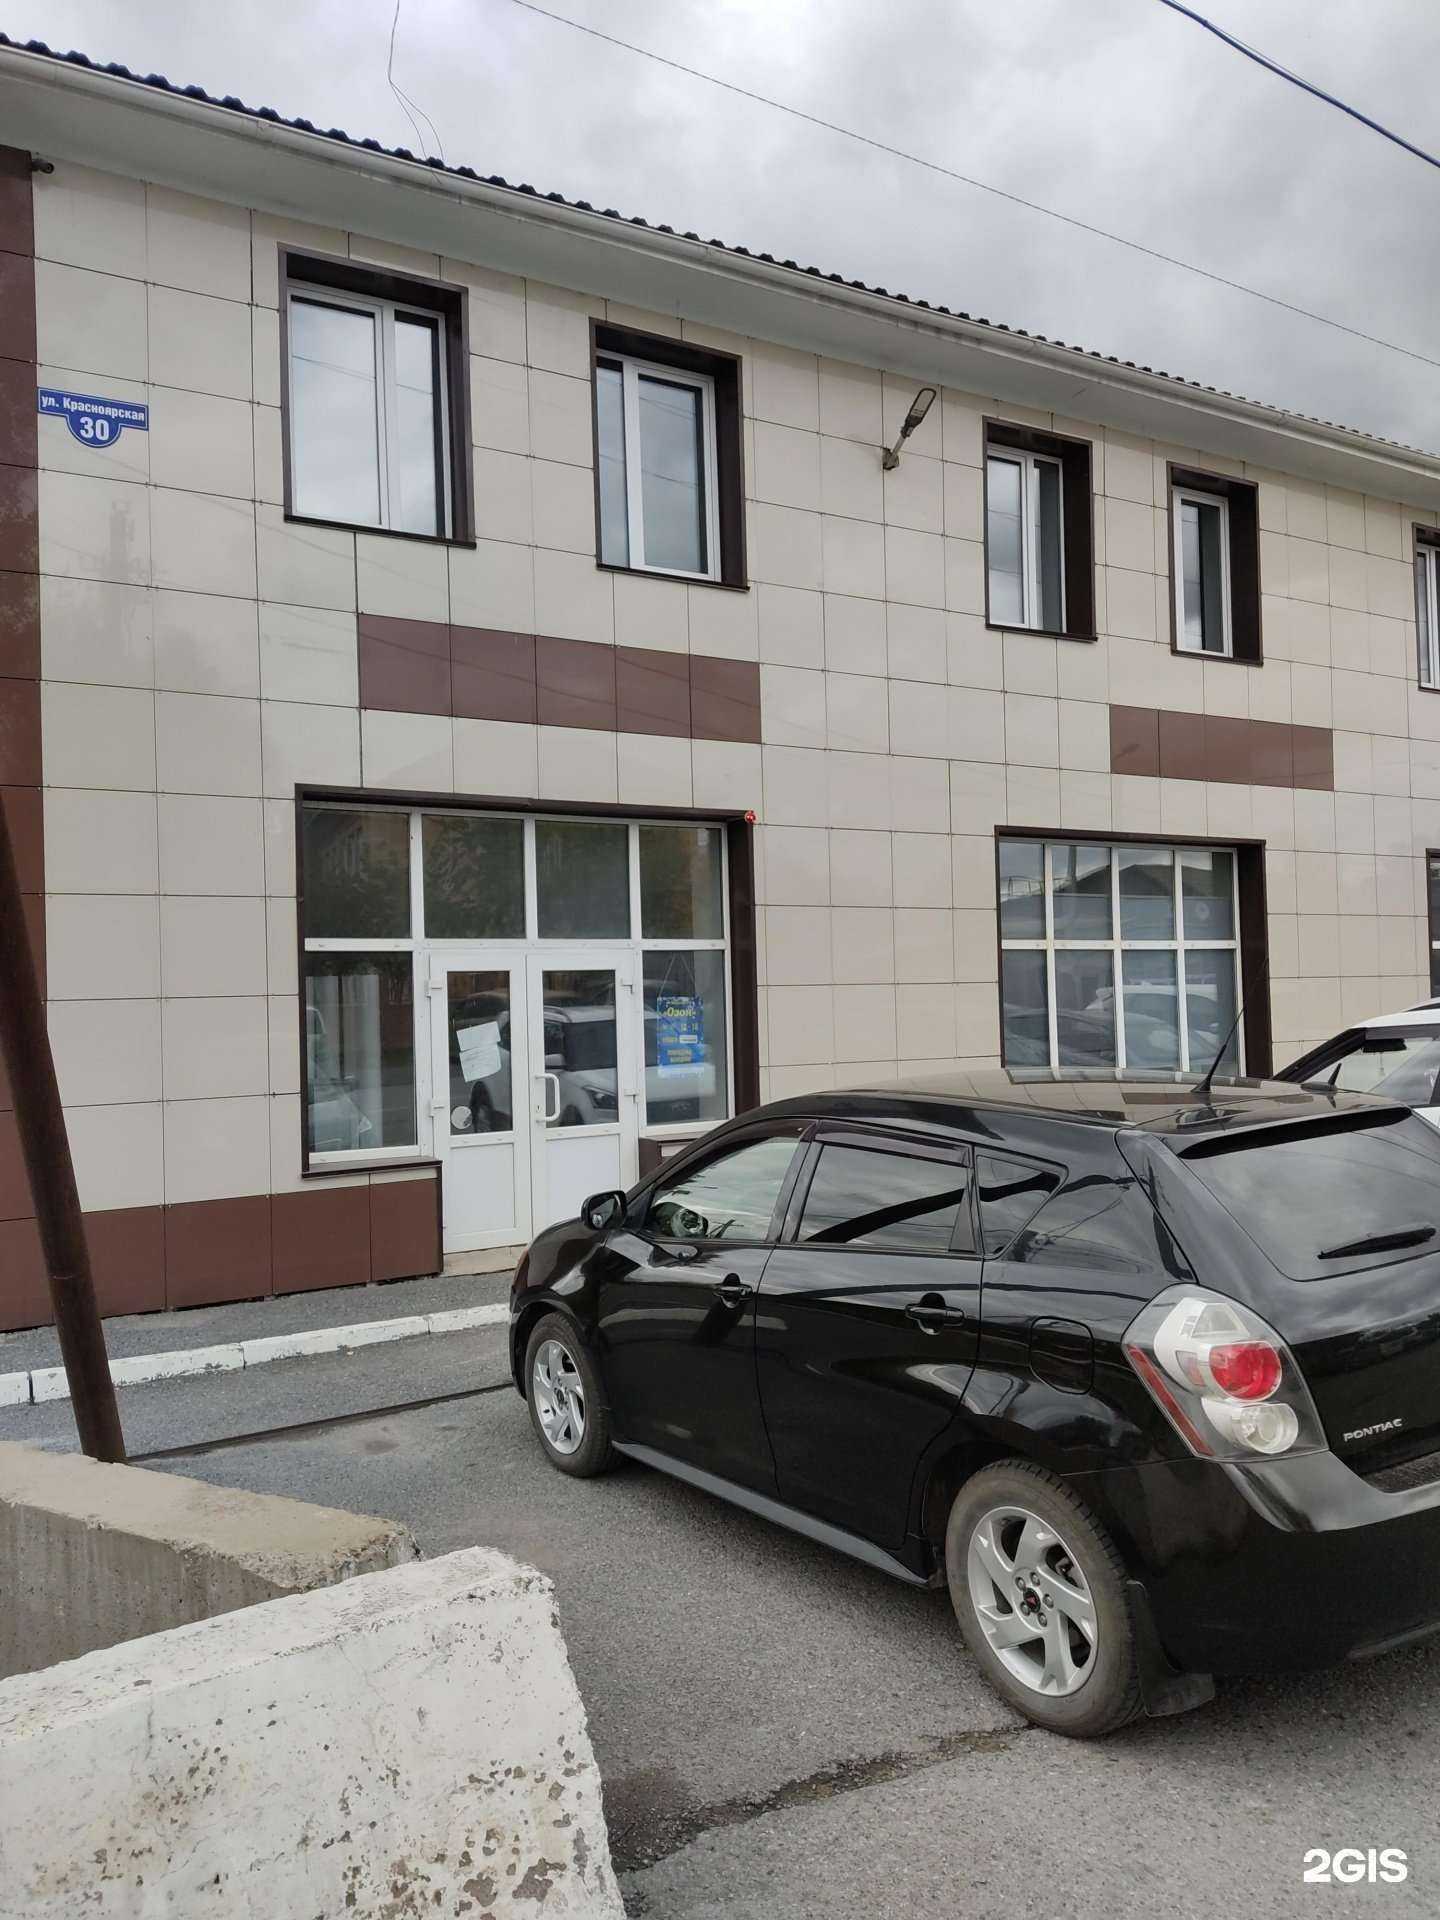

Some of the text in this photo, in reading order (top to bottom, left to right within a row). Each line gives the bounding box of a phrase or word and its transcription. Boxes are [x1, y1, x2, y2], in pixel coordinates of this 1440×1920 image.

[41, 395, 145, 422] ул. Красноярская
[79, 416, 110, 441] 30
[1343, 1418, 1403, 1442] PONTIAC
